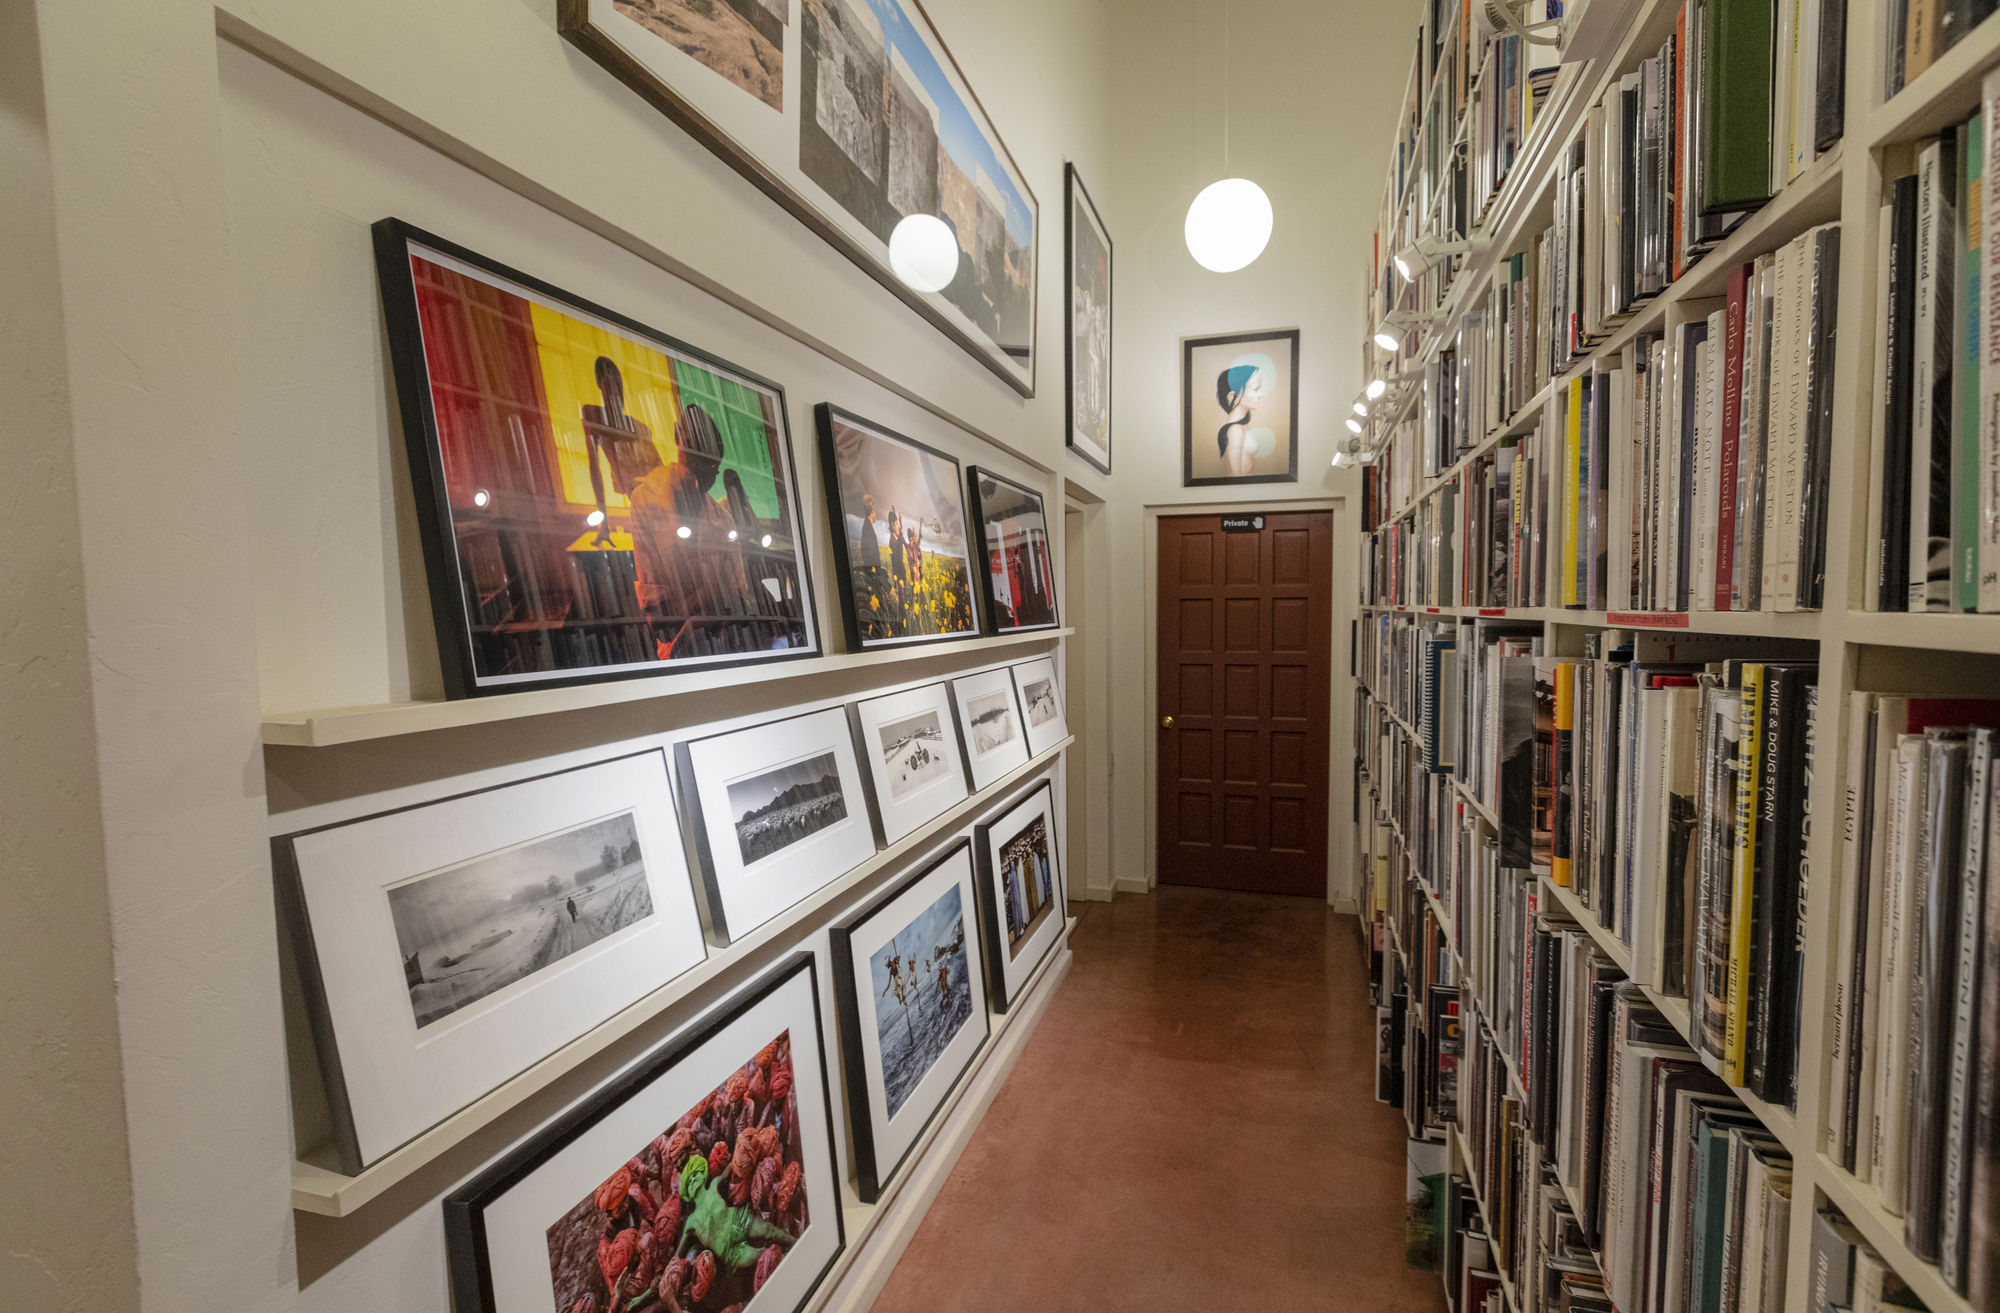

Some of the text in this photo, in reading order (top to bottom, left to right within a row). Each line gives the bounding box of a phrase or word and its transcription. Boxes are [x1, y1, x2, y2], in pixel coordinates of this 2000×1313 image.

[1921, 214, 1932, 280] Illustrated
[1990, 231, 2000, 267] OUR
[1774, 286, 1783, 356] DAYBOOKS
[1794, 274, 1803, 346] DAYBOOKS
[1989, 270, 2000, 367] RESISTANCE
[1773, 359, 1780, 375] OF
[1793, 349, 1800, 366] OF
[1703, 317, 1716, 473] MINAMATA NOTE
[1721, 298, 1738, 519] Carlo Mollino Polaroids
[1768, 381, 1780, 452] EDWARD
[1788, 372, 1800, 445] EDWARD
[1990, 392, 1999, 452] Photographs
[1765, 456, 1777, 530] WESTON
[1785, 449, 1796, 527] WESTON
[1990, 453, 1999, 467] by
[1223, 519, 1249, 527] Private
[1879, 539, 1887, 586] photolucida
[1735, 682, 1757, 848] TIME FRAMES
[1765, 679, 1780, 822] MIKE & DOUG STARN
[1702, 747, 1714, 860] ENDURING
[1844, 784, 1856, 843] EGYPTE
[1896, 831, 1904, 845] in
[1893, 872, 1902, 920] Small
[1960, 742, 1985, 1004] THROCKMORTON
[1696, 868, 1710, 966] NAVAHO
[1726, 958, 1738, 1048] MICHAEL SPANO
[1832, 983, 1844, 1060] bernard plossu
[1815, 1249, 1828, 1307] IRVING
